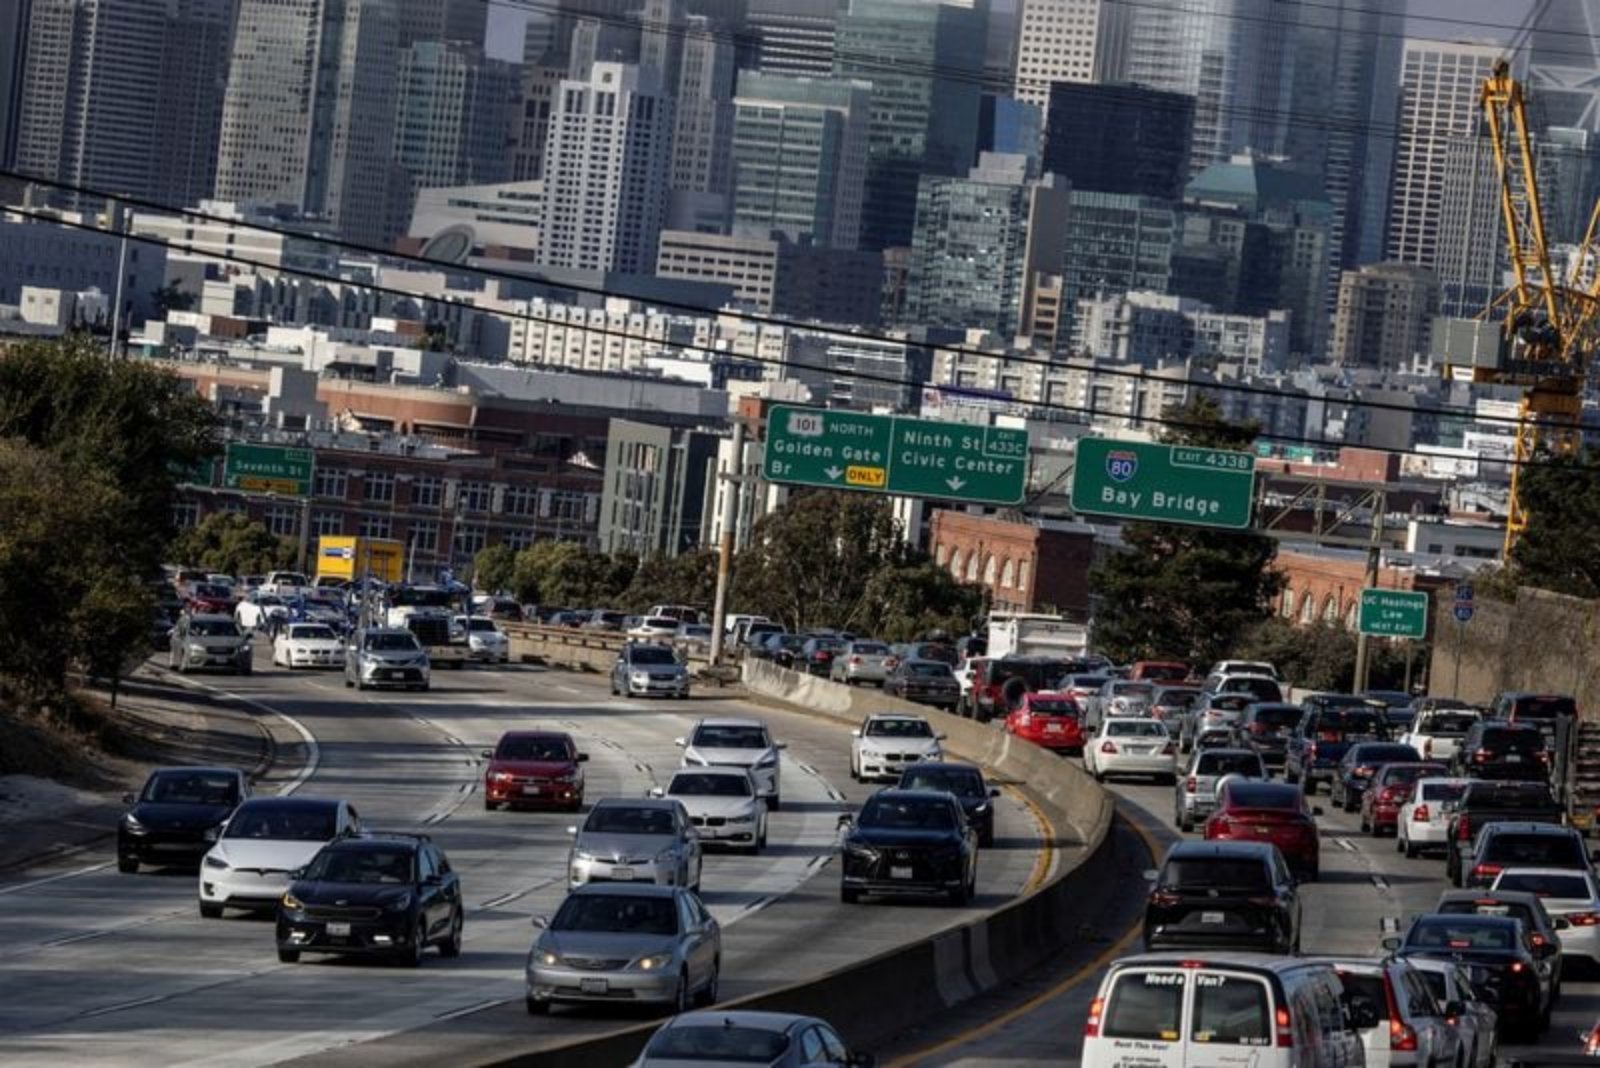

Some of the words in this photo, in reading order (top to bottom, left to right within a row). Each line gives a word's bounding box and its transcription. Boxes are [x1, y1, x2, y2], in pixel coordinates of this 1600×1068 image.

[796, 418, 817, 431] 101
[829, 422, 874, 436] NORTH
[903, 431, 953, 448] Ninth
[961, 436, 980, 451] St
[997, 431, 1016, 439] EXIT
[773, 439, 833, 457] Golden
[841, 445, 881, 462] Gate
[988, 441, 1024, 454] 433C
[236, 459, 285, 474] Seventh
[771, 460, 792, 475] Br
[902, 451, 946, 468] Civic
[954, 456, 1014, 474] Center
[1177, 451, 1200, 462] EXIT
[1205, 454, 1249, 469] 433B
[848, 469, 883, 481] ONLY
[1111, 461, 1131, 476] 80
[1101, 486, 1142, 509] Bay
[1152, 491, 1220, 516] Bridge
[1145, 972, 1177, 985] Need
[1197, 975, 1225, 987] Van?
